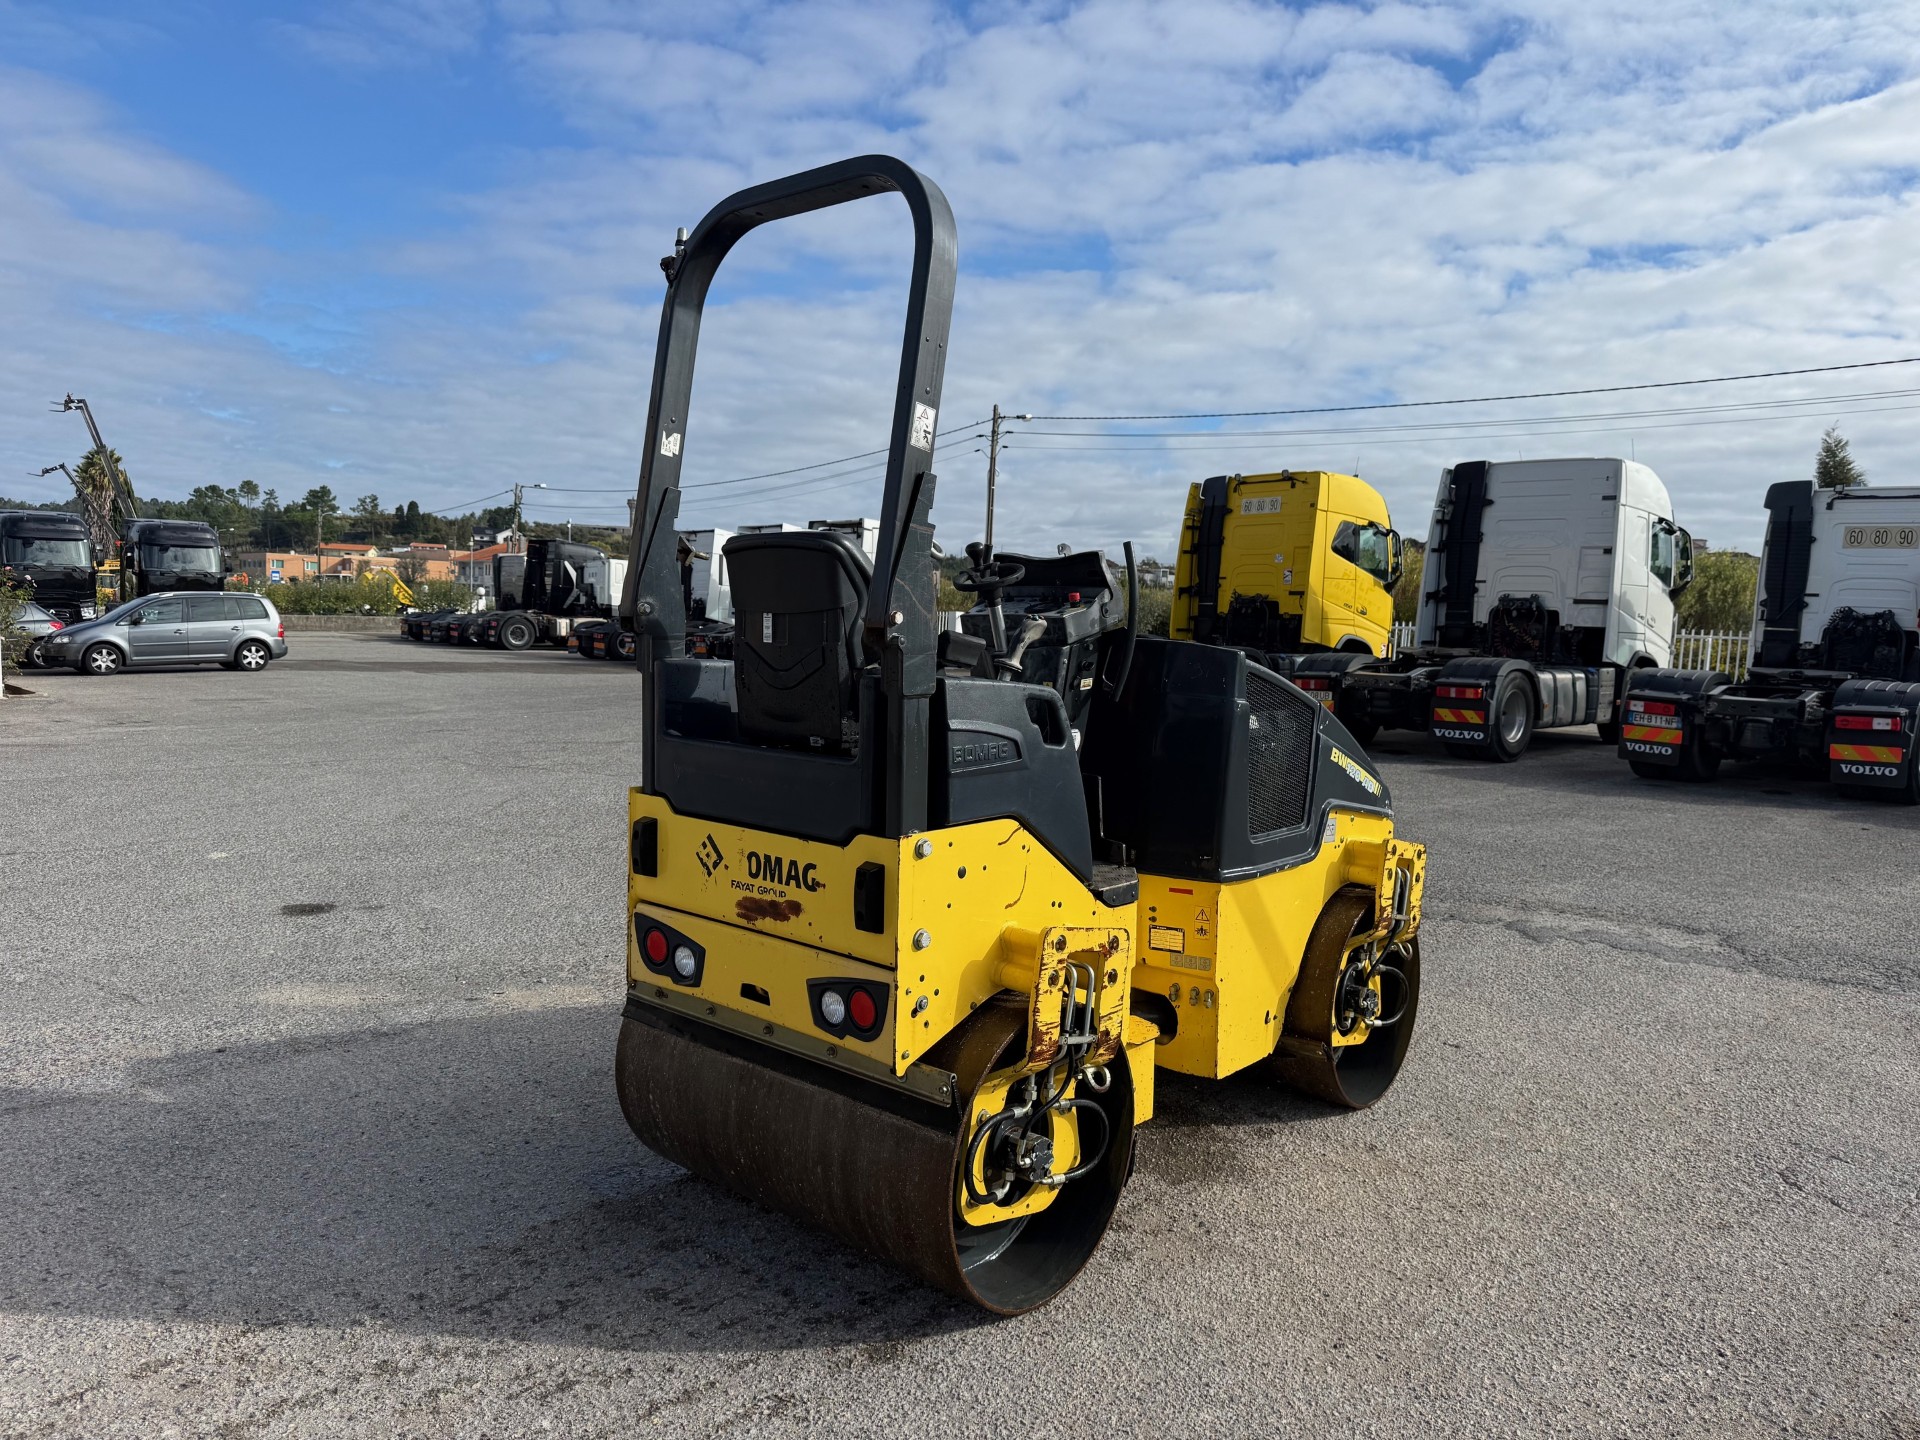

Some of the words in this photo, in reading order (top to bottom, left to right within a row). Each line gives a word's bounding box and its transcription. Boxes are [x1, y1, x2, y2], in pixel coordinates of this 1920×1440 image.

[1244, 501, 1252, 512] 60
[1256, 500, 1265, 512] 80
[1269, 499, 1278, 511] 90
[1849, 530, 1863, 545] 60
[1873, 530, 1888, 545] 80
[1899, 530, 1914, 545] 90
[1432, 728, 1485, 740] VOLVO
[952, 741, 1009, 764] BOMAG
[1625, 742, 1673, 755] VOLVO
[1839, 763, 1898, 777] VOLVO
[730, 879, 755, 894] FAYAT
